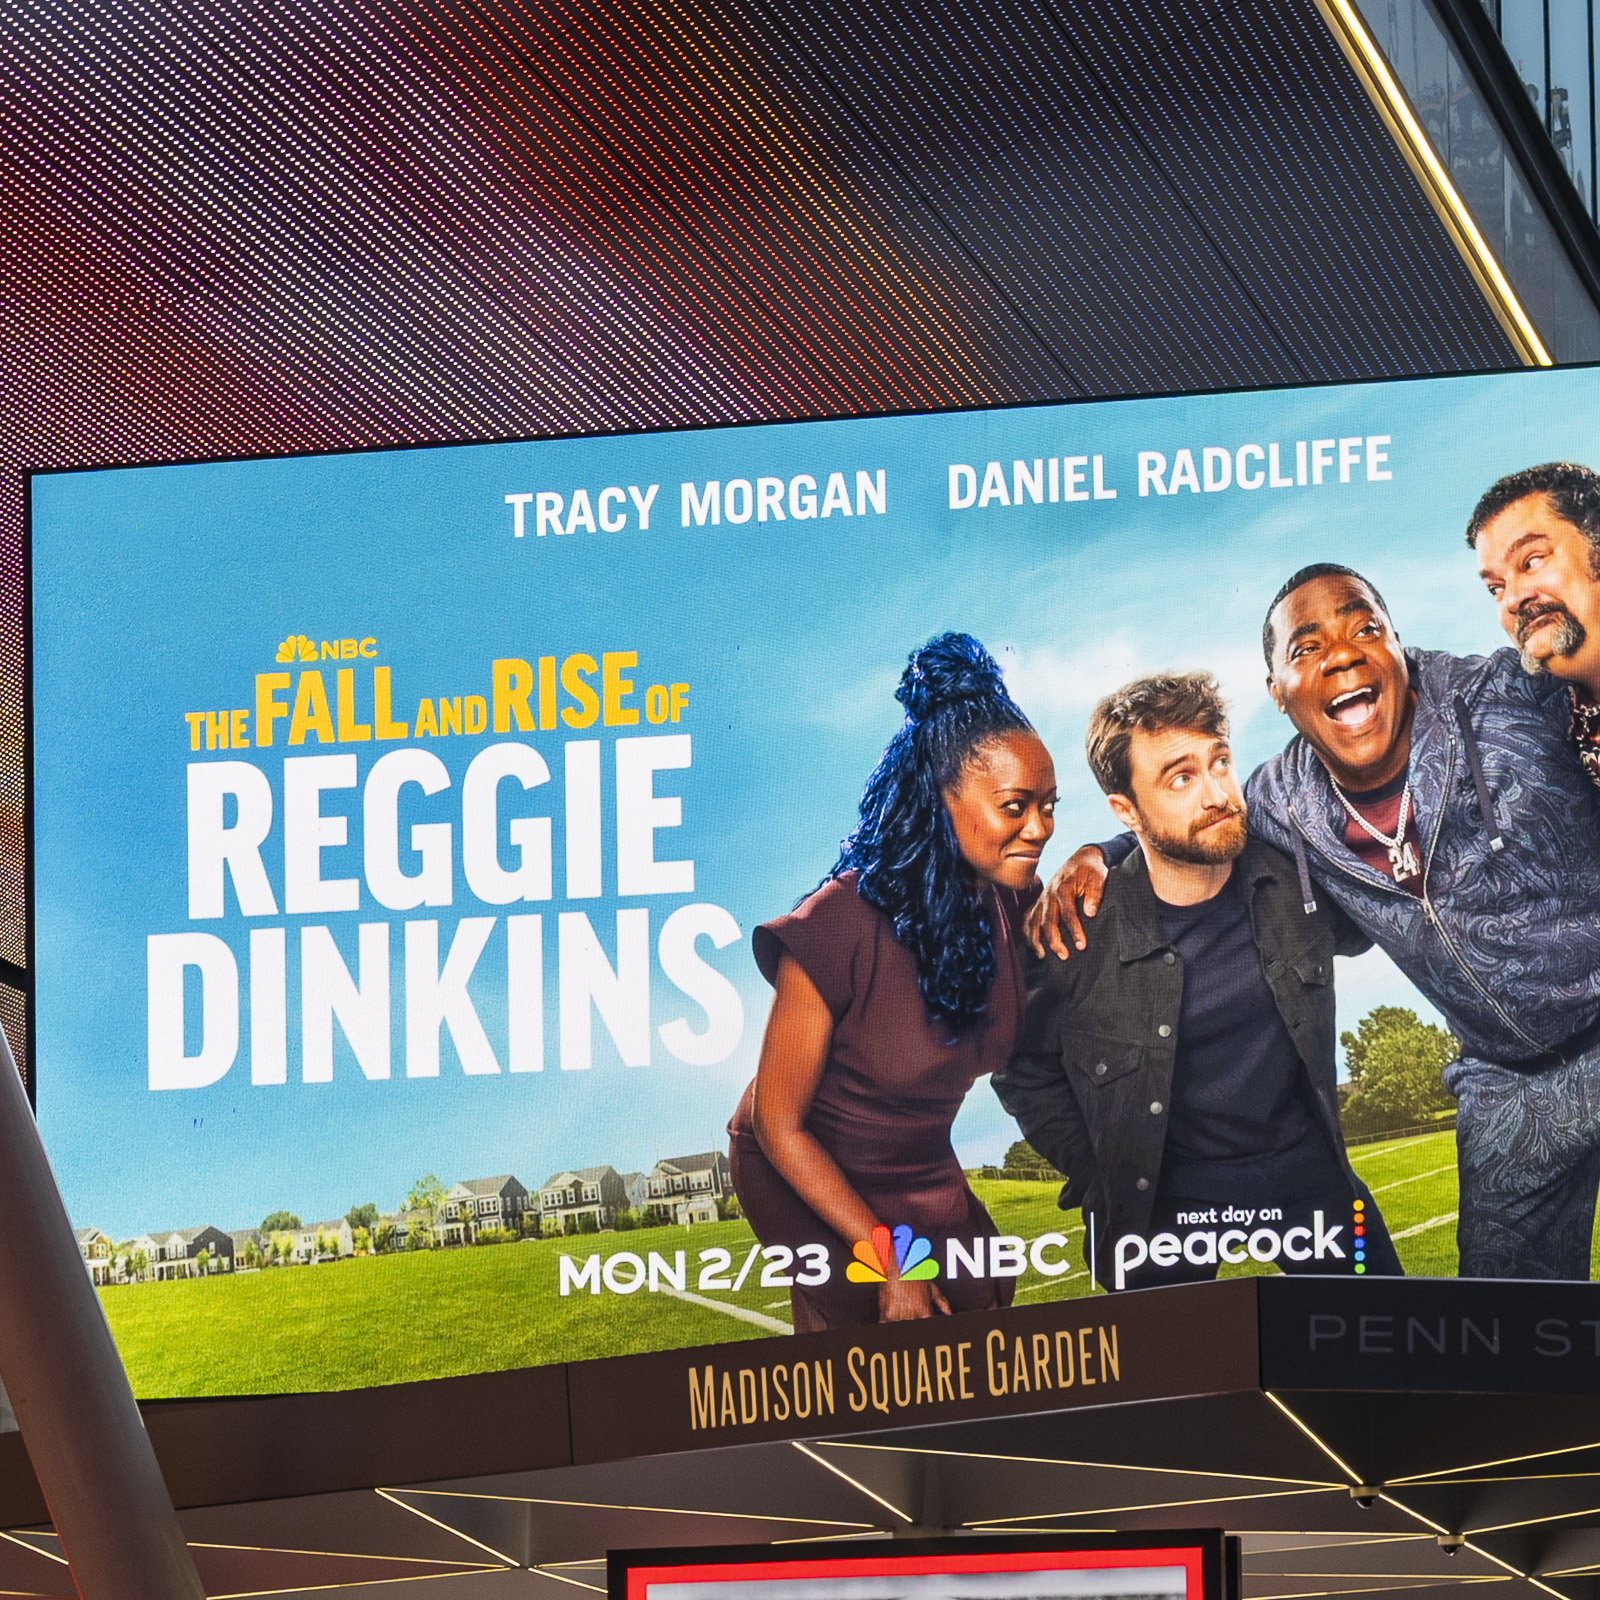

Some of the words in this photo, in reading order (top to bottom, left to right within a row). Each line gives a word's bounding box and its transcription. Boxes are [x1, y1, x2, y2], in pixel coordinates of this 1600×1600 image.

[505, 484, 660, 538] TRACY
[681, 470, 887, 527] MORGAN
[947, 454, 1117, 509] DANIEL
[1136, 434, 1393, 497] RADCLIFFE
[321, 637, 377, 660] NBC
[185, 709, 250, 751] THE
[255, 666, 408, 747] FALL
[415, 695, 487, 738] AND
[492, 651, 639, 734] RISE
[646, 682, 690, 725] OF
[186, 734, 694, 920] REGGIE
[1388, 842, 1420, 882] 24
[147, 902, 743, 1091] DINKINS
[1115, 1210, 1346, 1290] peacock
[1177, 1210, 1217, 1225] next
[1221, 1208, 1254, 1226] day
[1258, 1207, 1283, 1222] on
[558, 1249, 693, 1297] MON
[698, 1242, 831, 1292] 2/23
[947, 1233, 1071, 1280] NBC
[1308, 1313, 1501, 1356] PENN
[688, 1360, 840, 1430] MADISON
[849, 1341, 972, 1414] SQUARE
[987, 1325, 1120, 1397] GARDEN
